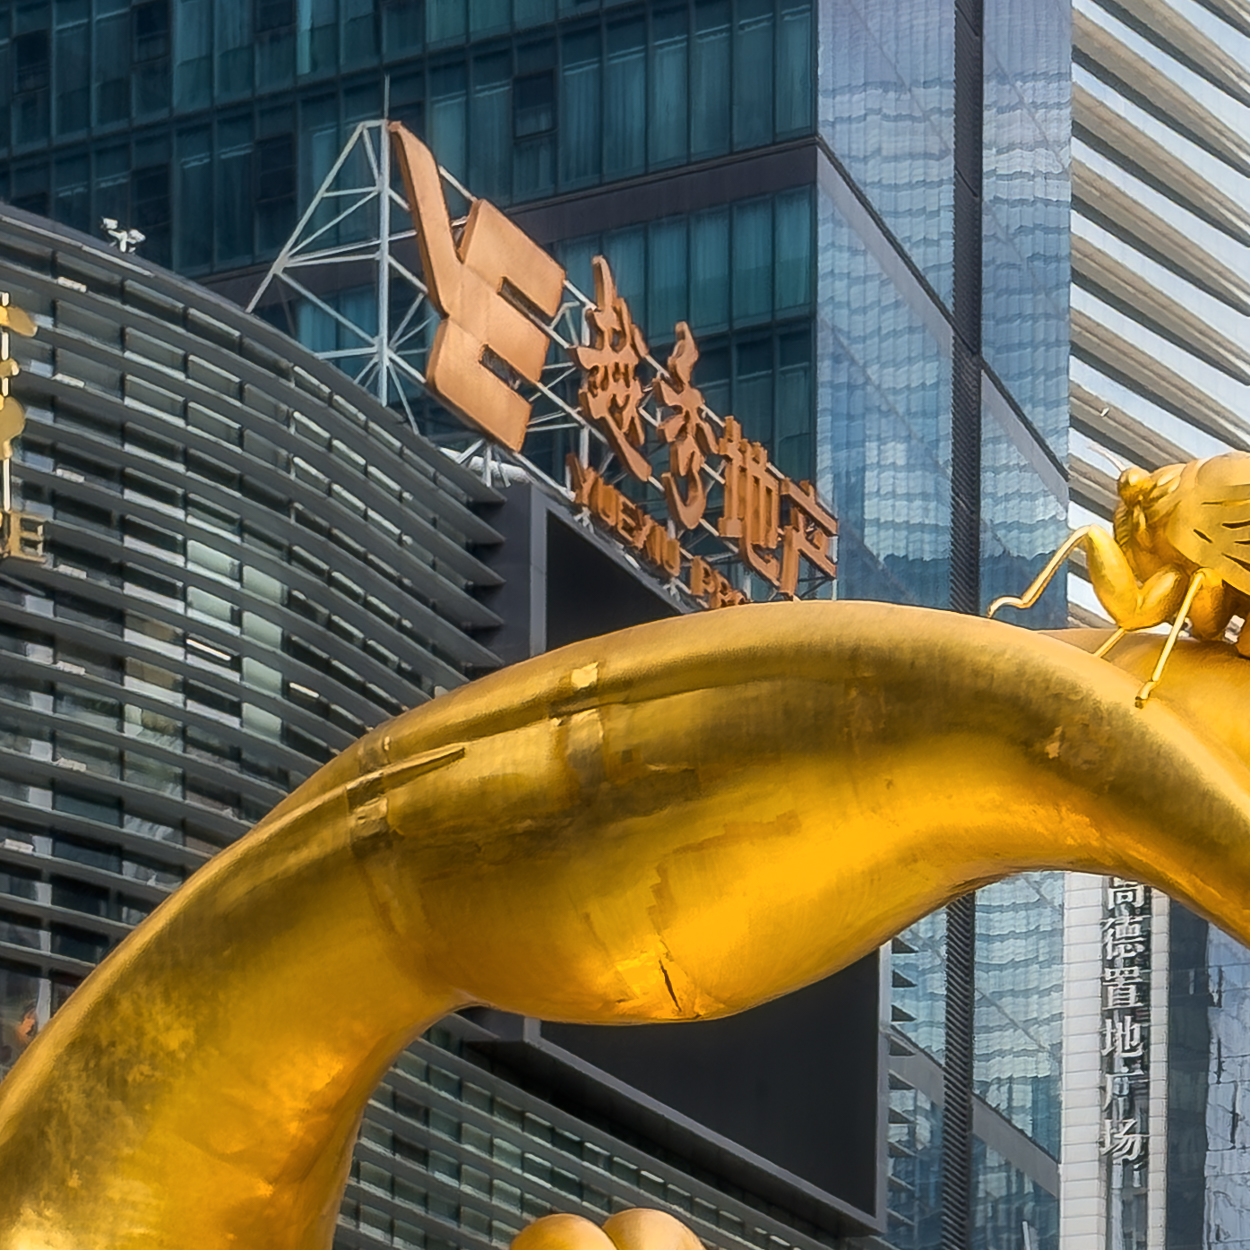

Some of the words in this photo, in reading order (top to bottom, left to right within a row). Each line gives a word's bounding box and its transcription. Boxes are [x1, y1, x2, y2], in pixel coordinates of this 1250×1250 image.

[566, 452, 681, 577] YUEXIU
[568, 255, 838, 600] 越秀地产
